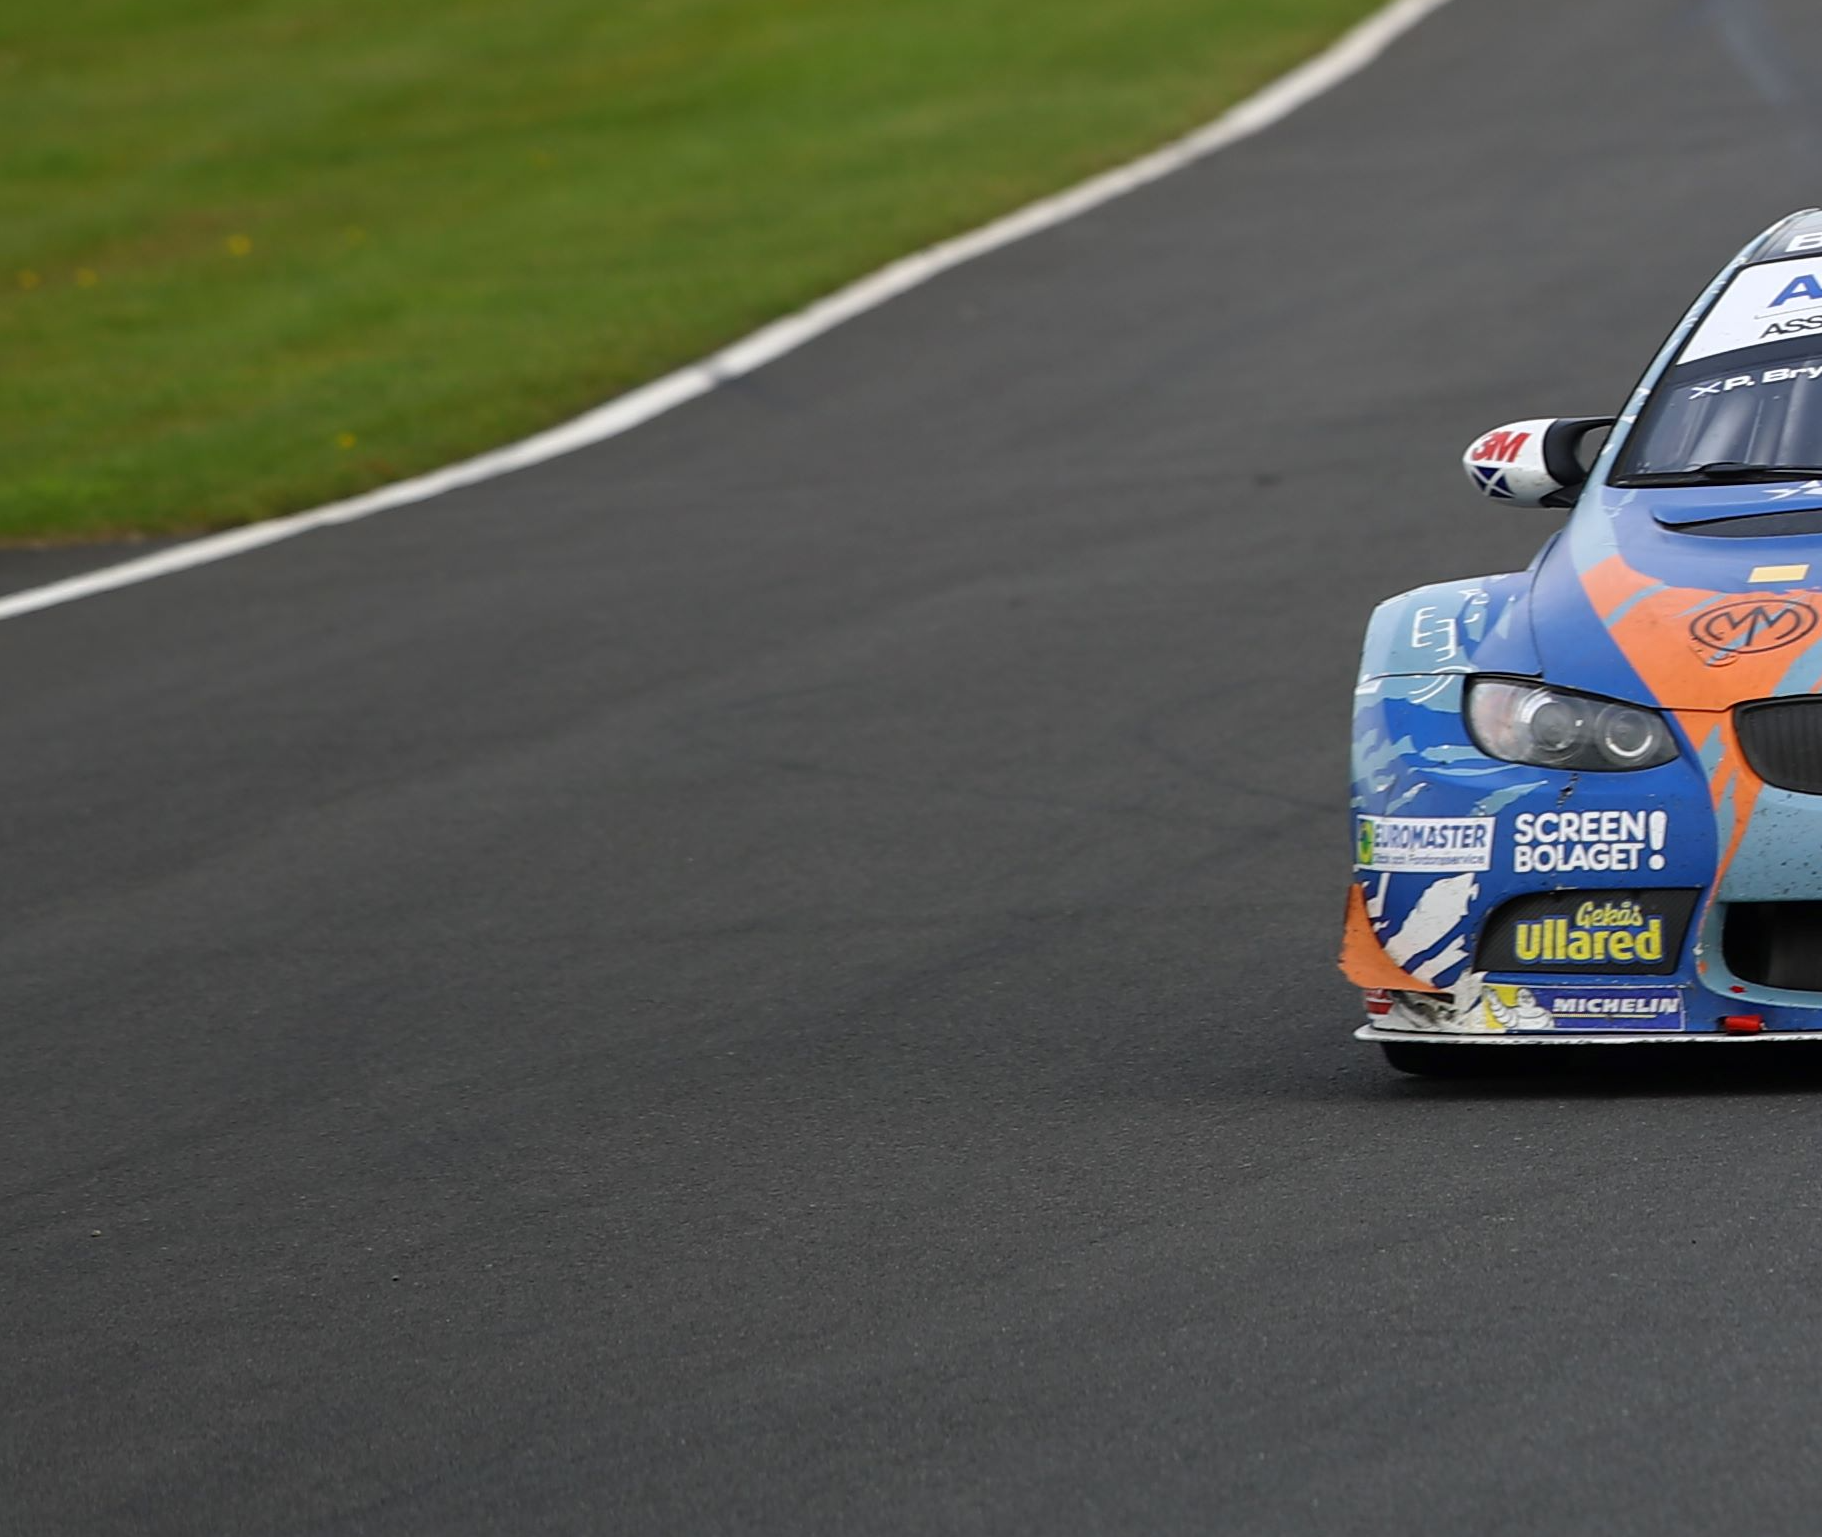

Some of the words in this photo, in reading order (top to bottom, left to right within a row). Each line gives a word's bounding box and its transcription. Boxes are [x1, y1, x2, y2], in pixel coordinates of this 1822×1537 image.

[1723, 374, 1755, 391] P.
[1471, 430, 1533, 463] 3M
[1575, 901, 1643, 928] Gekås
[1515, 917, 1663, 963] Ullared
[1552, 997, 1681, 1015] MICHELIN
